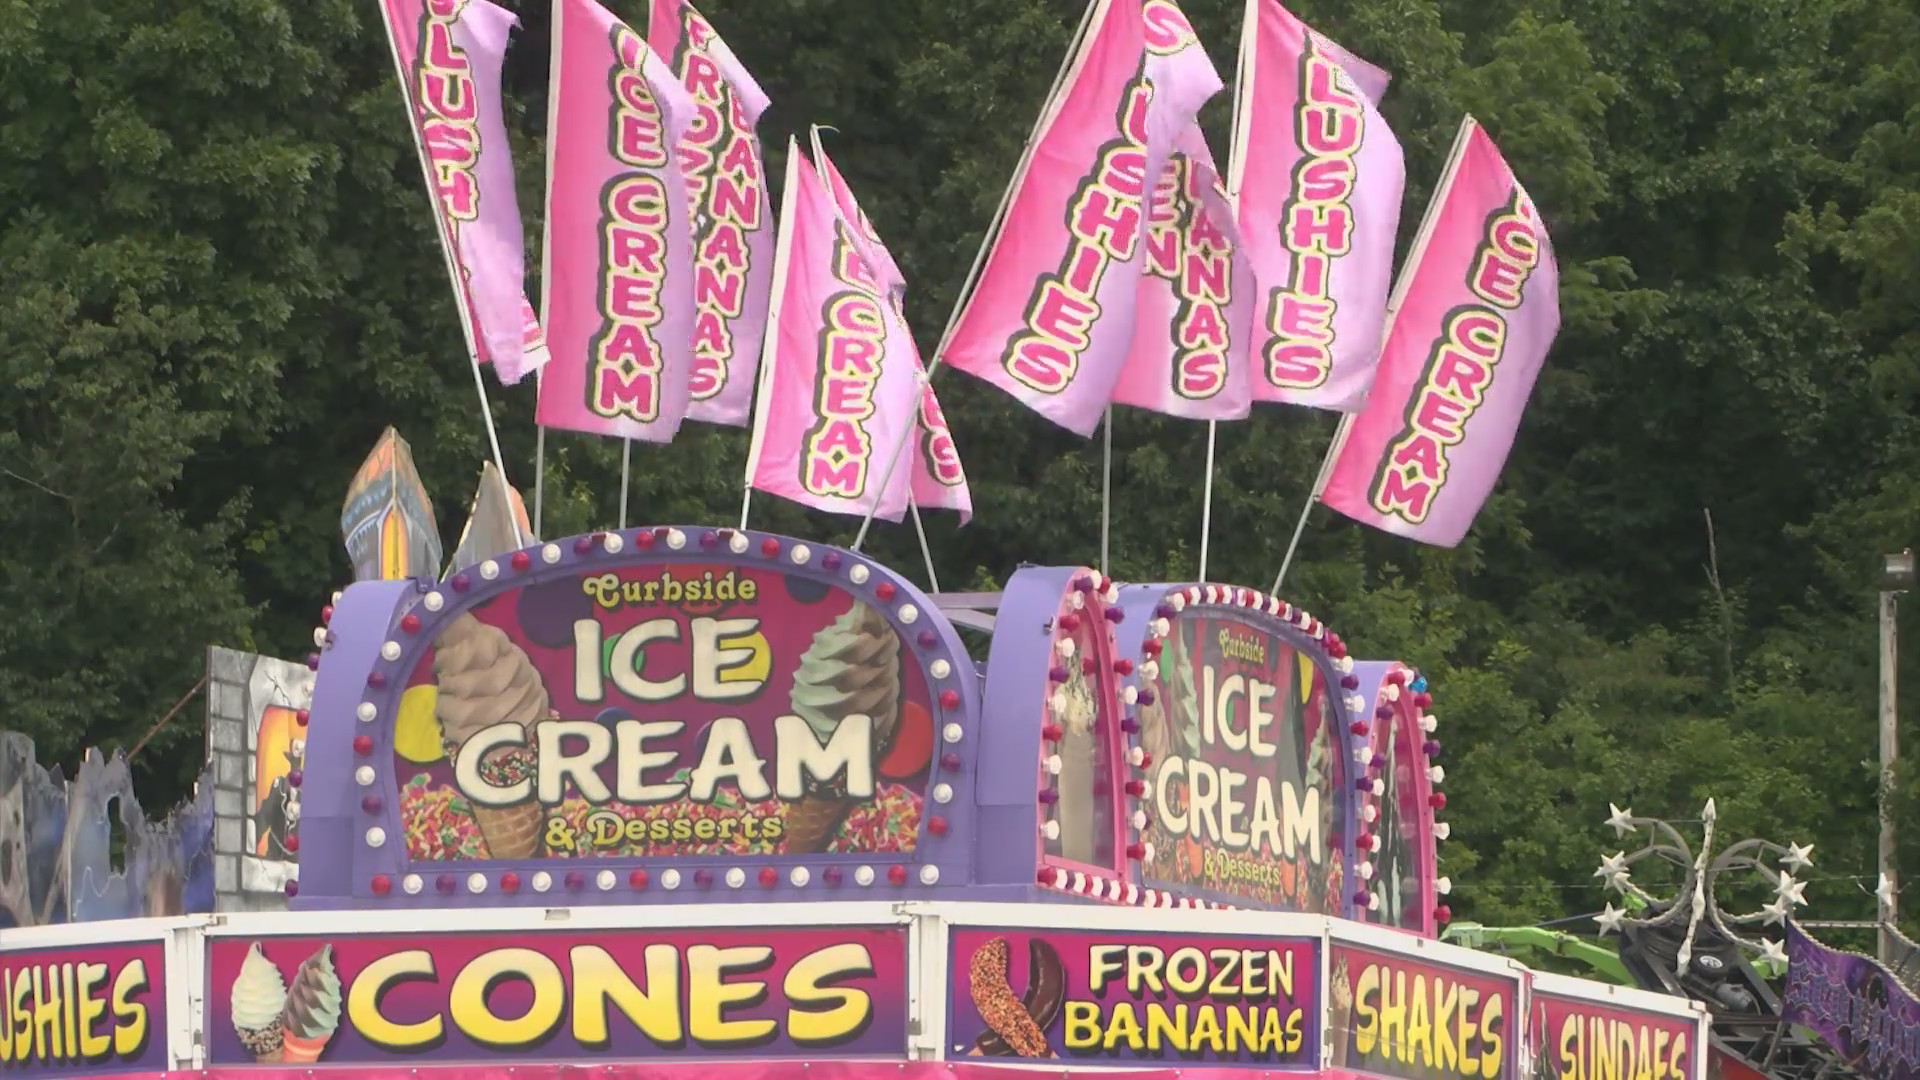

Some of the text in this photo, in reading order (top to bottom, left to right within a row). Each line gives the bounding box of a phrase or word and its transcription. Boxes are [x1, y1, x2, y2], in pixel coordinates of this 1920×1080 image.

[594, 23, 669, 423] ICE CREAM
[1270, 38, 1365, 390] LUSHIES
[805, 294, 887, 498] CREAM
[1372, 310, 1507, 525] CREAM
[583, 572, 757, 607] Curbside
[573, 617, 765, 702] ICE
[455, 713, 876, 805] CREAM
[1202, 664, 1277, 757] ICE
[545, 812, 784, 849] & Desserts
[1156, 755, 1321, 865] CREAM
[347, 943, 875, 1047] CONES
[1088, 944, 1295, 997] FROZEN
[1063, 1000, 1303, 1055] BANANAS
[1355, 962, 1503, 1079] SHAKES
